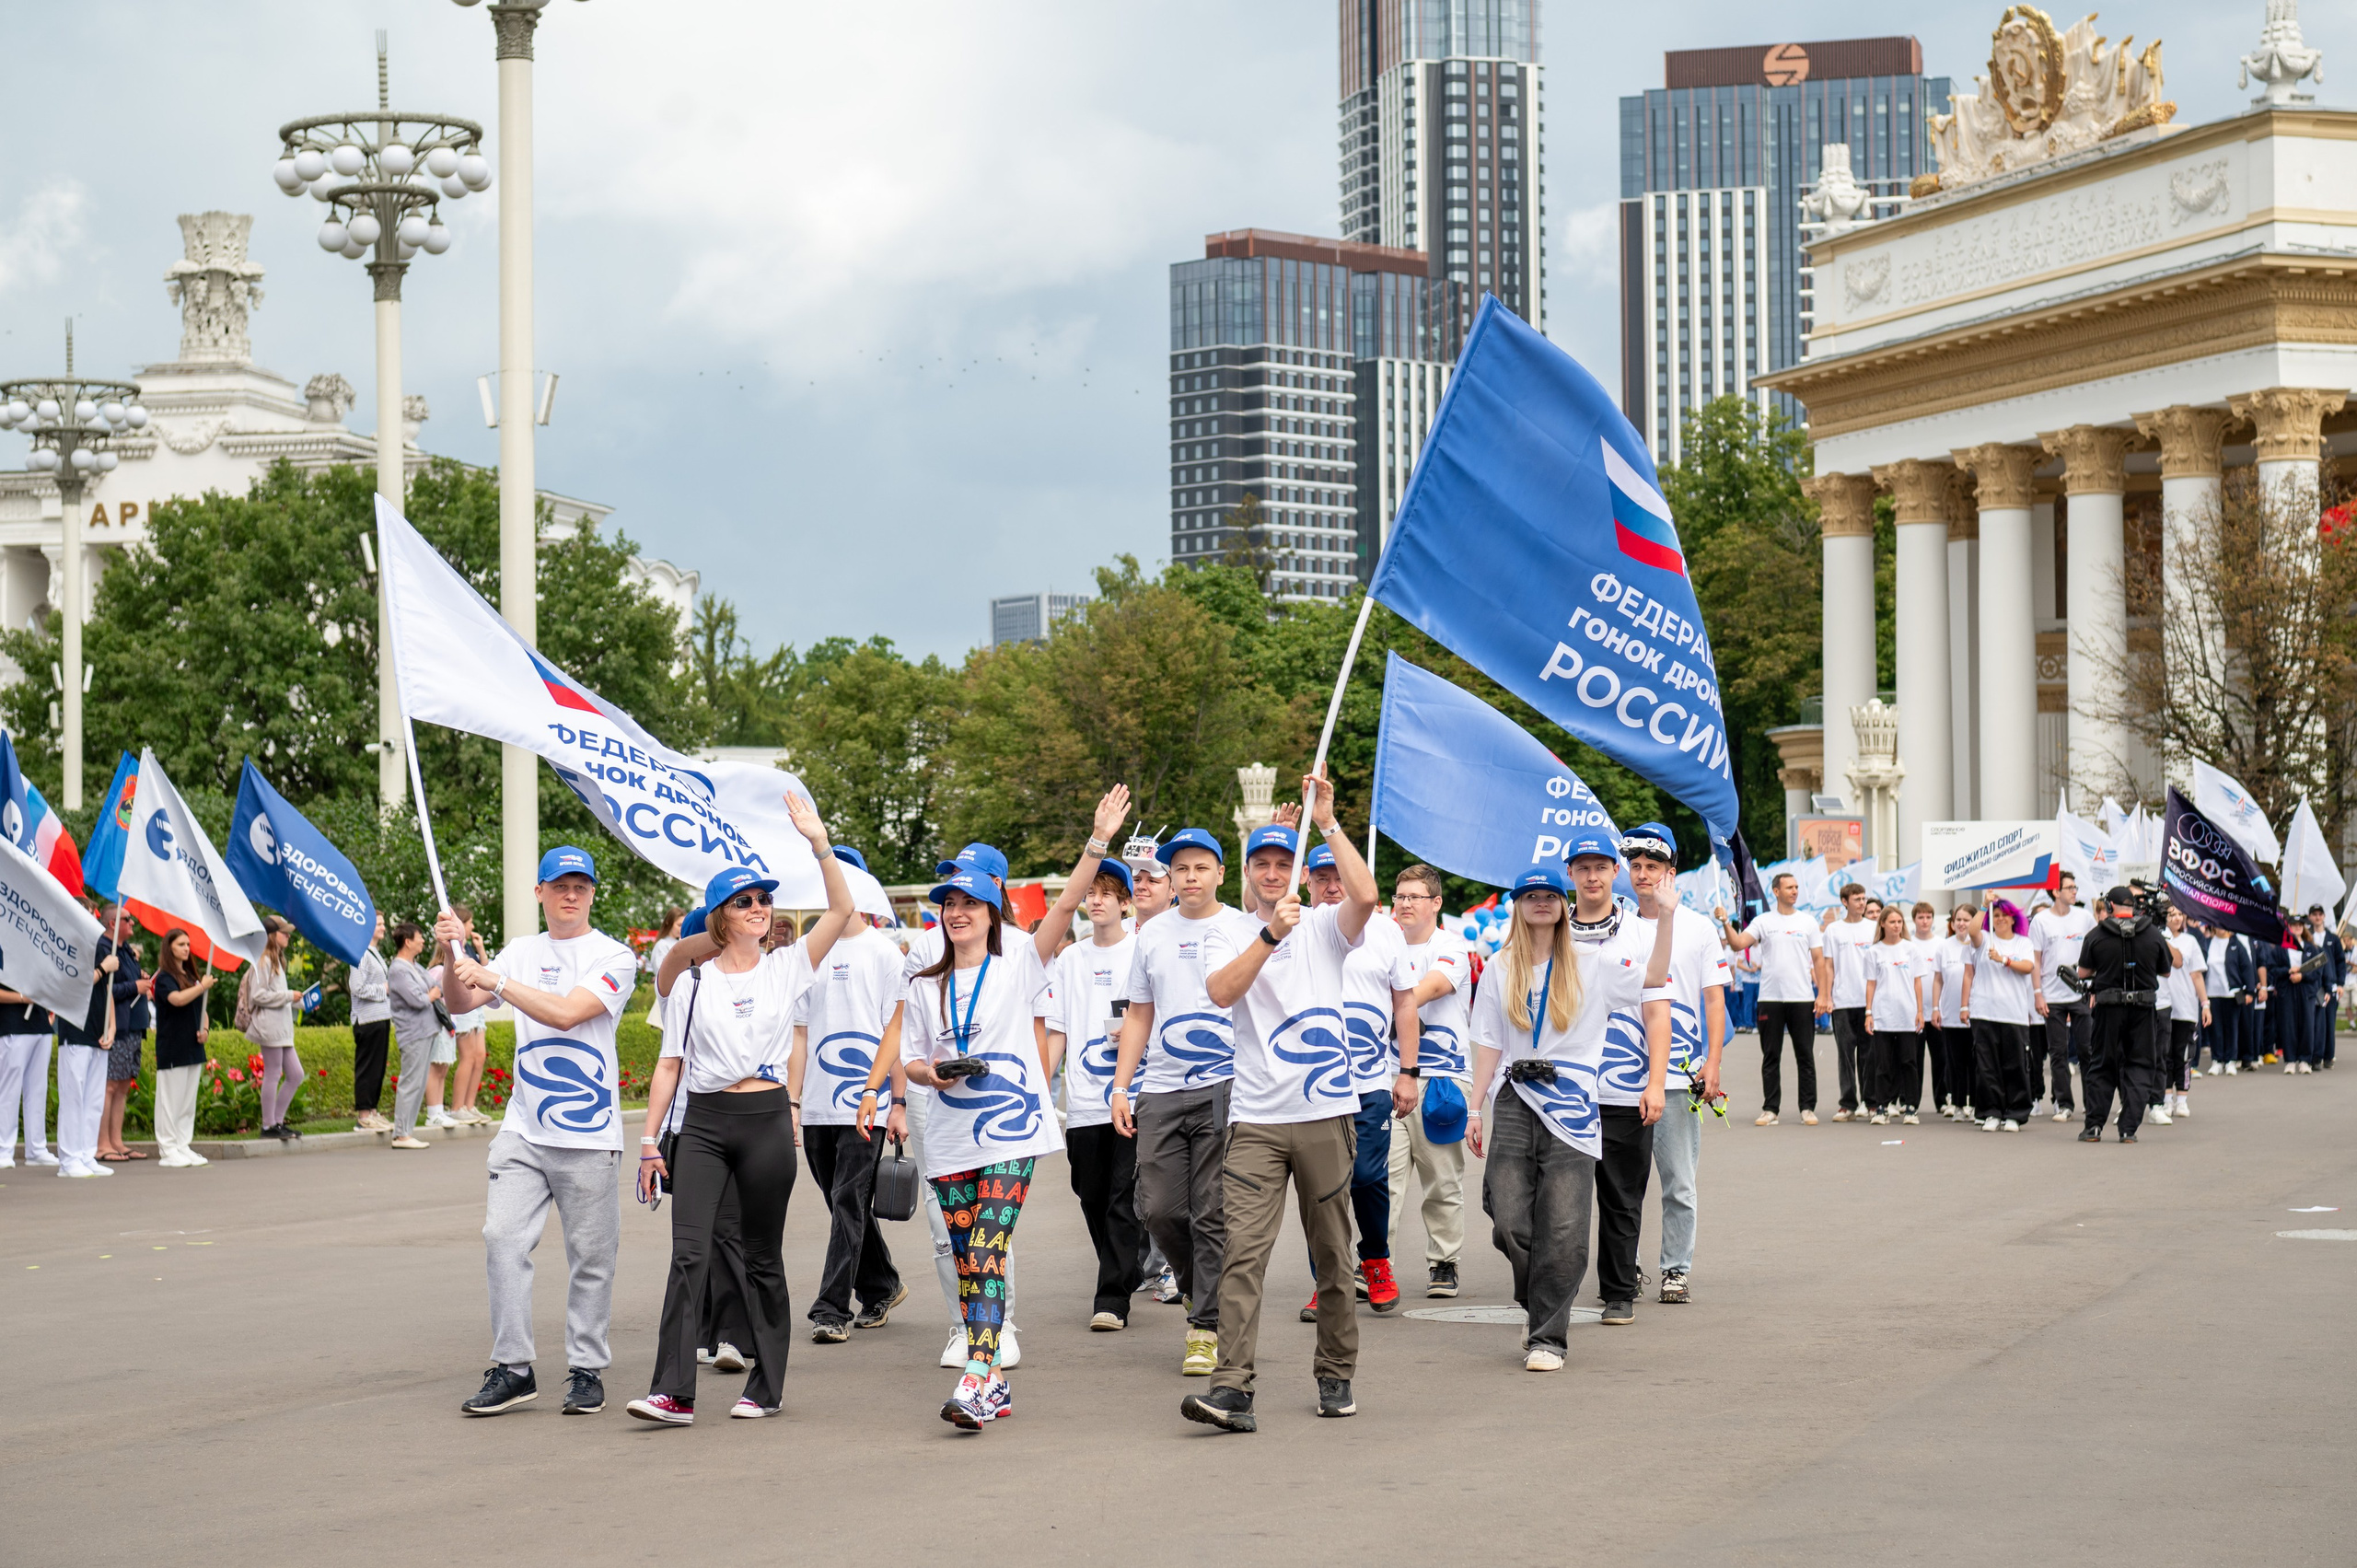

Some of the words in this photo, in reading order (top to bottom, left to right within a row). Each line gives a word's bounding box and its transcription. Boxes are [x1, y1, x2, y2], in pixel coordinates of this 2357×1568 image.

[1901, 238, 2000, 283] СОВЕТСКАЯ
[2009, 195, 2160, 253] ФЕДЕРАТИВНАЯ
[1934, 185, 2115, 253] РОССИЙСКАЯ
[2060, 219, 2163, 263] РЕСПУБЛИКА
[1568, 607, 1666, 675] ГОНОК
[1663, 661, 1724, 720] ДРОН
[1538, 641, 1729, 781] РОССИИ
[281, 842, 367, 914] ЗДОРОВОЕ
[1944, 842, 1996, 875] ФИДЖИТАЛ
[1997, 827, 2024, 849] СПОРТ
[2166, 858, 2226, 897] ВСЕРОССИЙСКАЯ
[2167, 835, 2236, 889] ВФФС
[0, 880, 78, 960] ЗДОРОВОЕ
[2200, 894, 2235, 912] СПОРТА
[0, 902, 79, 979] ОТЕЧЕСТВО
